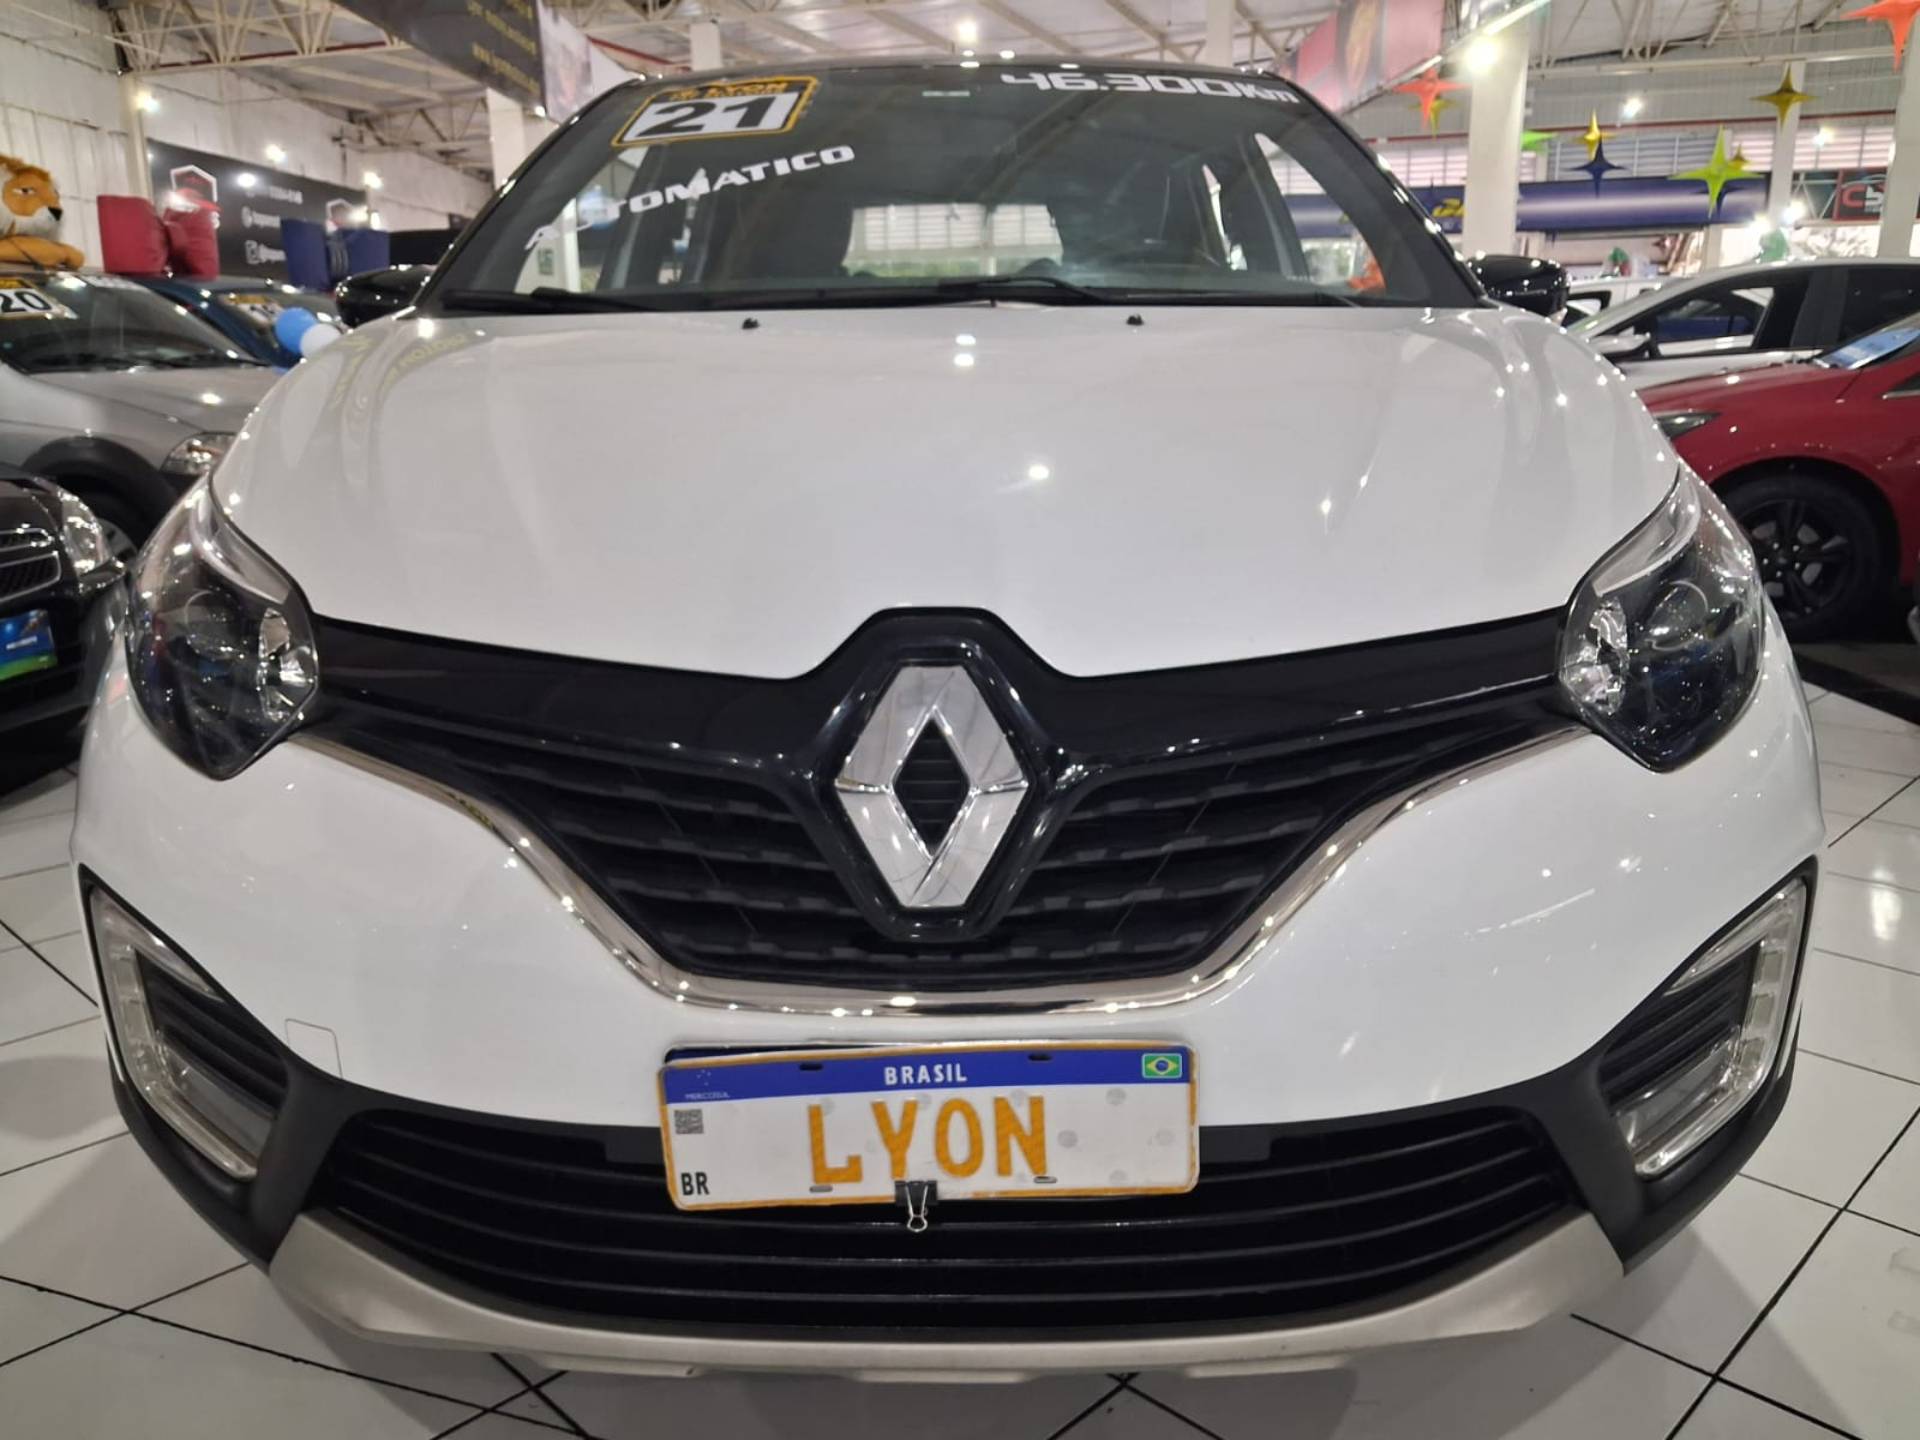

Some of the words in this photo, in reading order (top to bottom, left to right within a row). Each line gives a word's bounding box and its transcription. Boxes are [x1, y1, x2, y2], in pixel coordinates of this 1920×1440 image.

[635, 96, 777, 137] 21
[0, 291, 52, 313] 20
[884, 1063, 968, 1086] BRASIL
[808, 1096, 1047, 1184] LYON
[681, 1172, 710, 1196] BR
